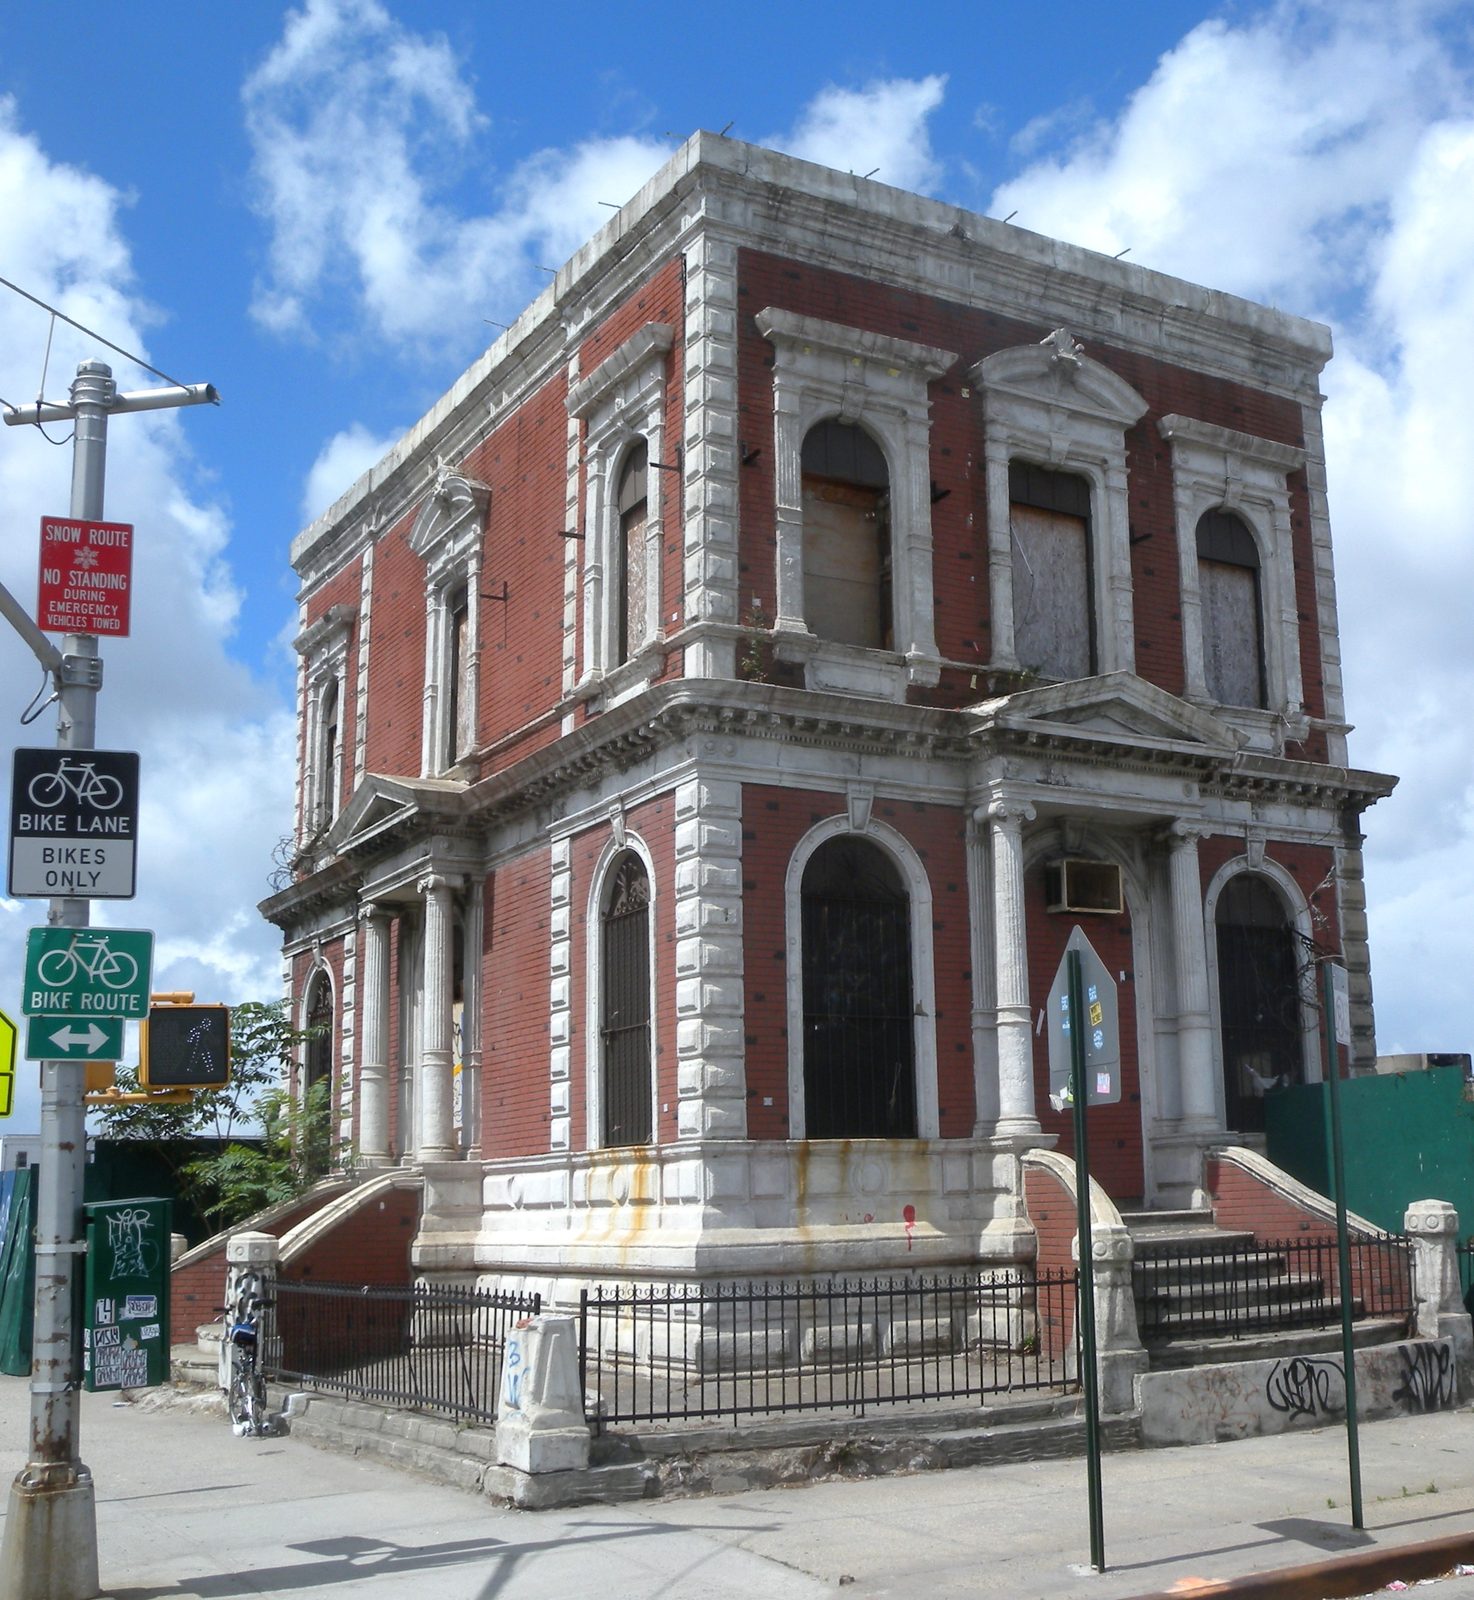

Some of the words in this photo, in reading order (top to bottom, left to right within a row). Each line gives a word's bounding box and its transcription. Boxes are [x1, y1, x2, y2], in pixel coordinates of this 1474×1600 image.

[45, 524, 82, 543] SNOW
[89, 528, 129, 547] ROUTE
[43, 568, 60, 585] NO
[68, 570, 127, 590] STANDING
[64, 588, 106, 602] DURING
[49, 600, 118, 616] EMERGENCY
[47, 614, 87, 628] VEHICLES
[92, 617, 120, 630] TOWED
[19, 813, 67, 831] BIKE
[77, 815, 130, 833] LANE
[42, 847, 106, 865] BIKES
[46, 870, 101, 887] ONLY
[31, 991, 73, 1009] BIKE
[81, 992, 140, 1011] ROUTE
